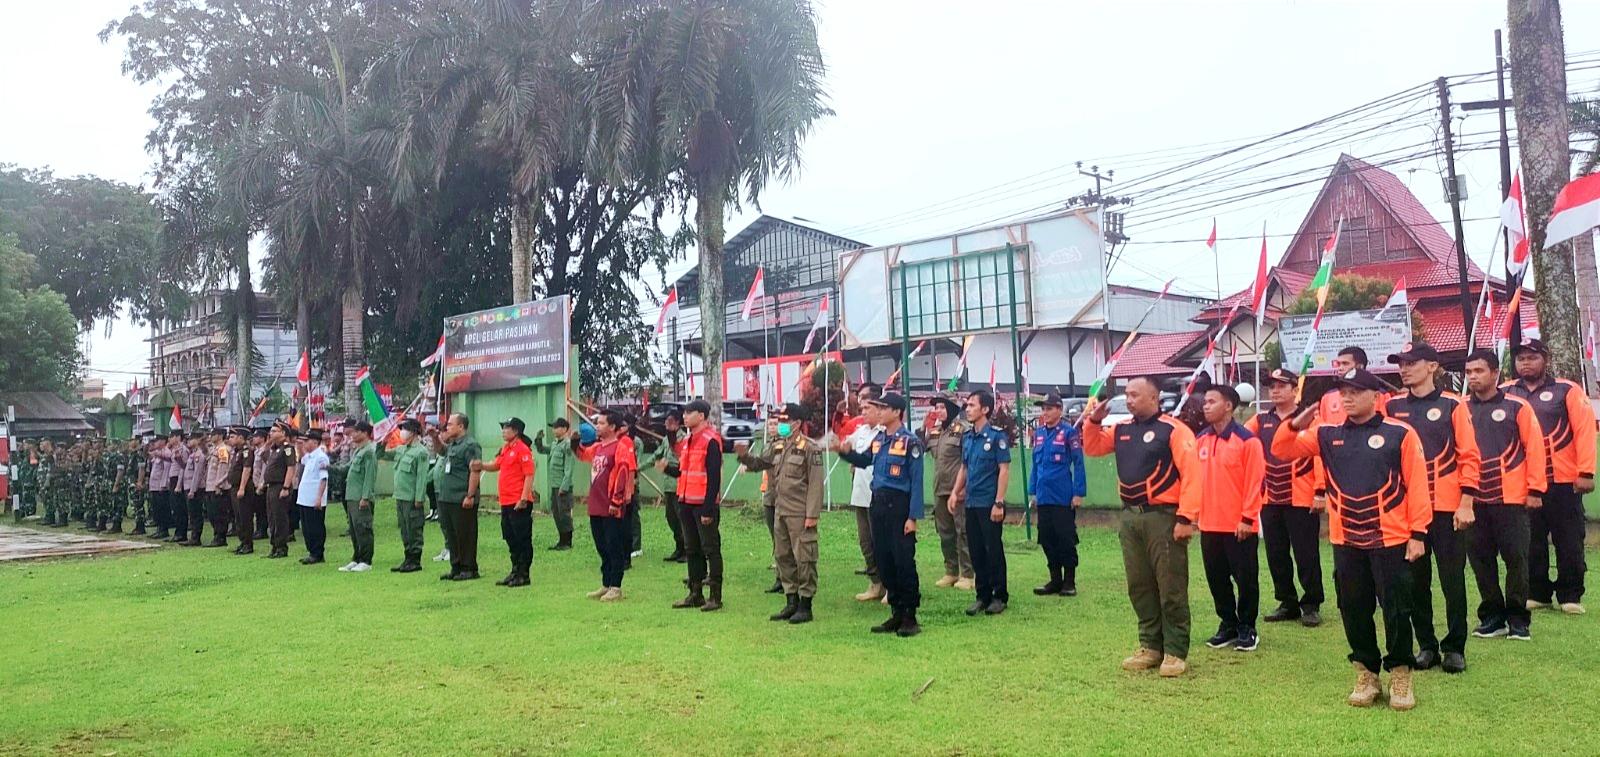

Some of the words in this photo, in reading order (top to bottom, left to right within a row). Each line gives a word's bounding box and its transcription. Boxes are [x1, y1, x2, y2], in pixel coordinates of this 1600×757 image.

[464, 334, 480, 345] APEL
[481, 329, 502, 342] GELAR
[505, 323, 538, 339] PASUKAN
[547, 353, 561, 362] 2023
